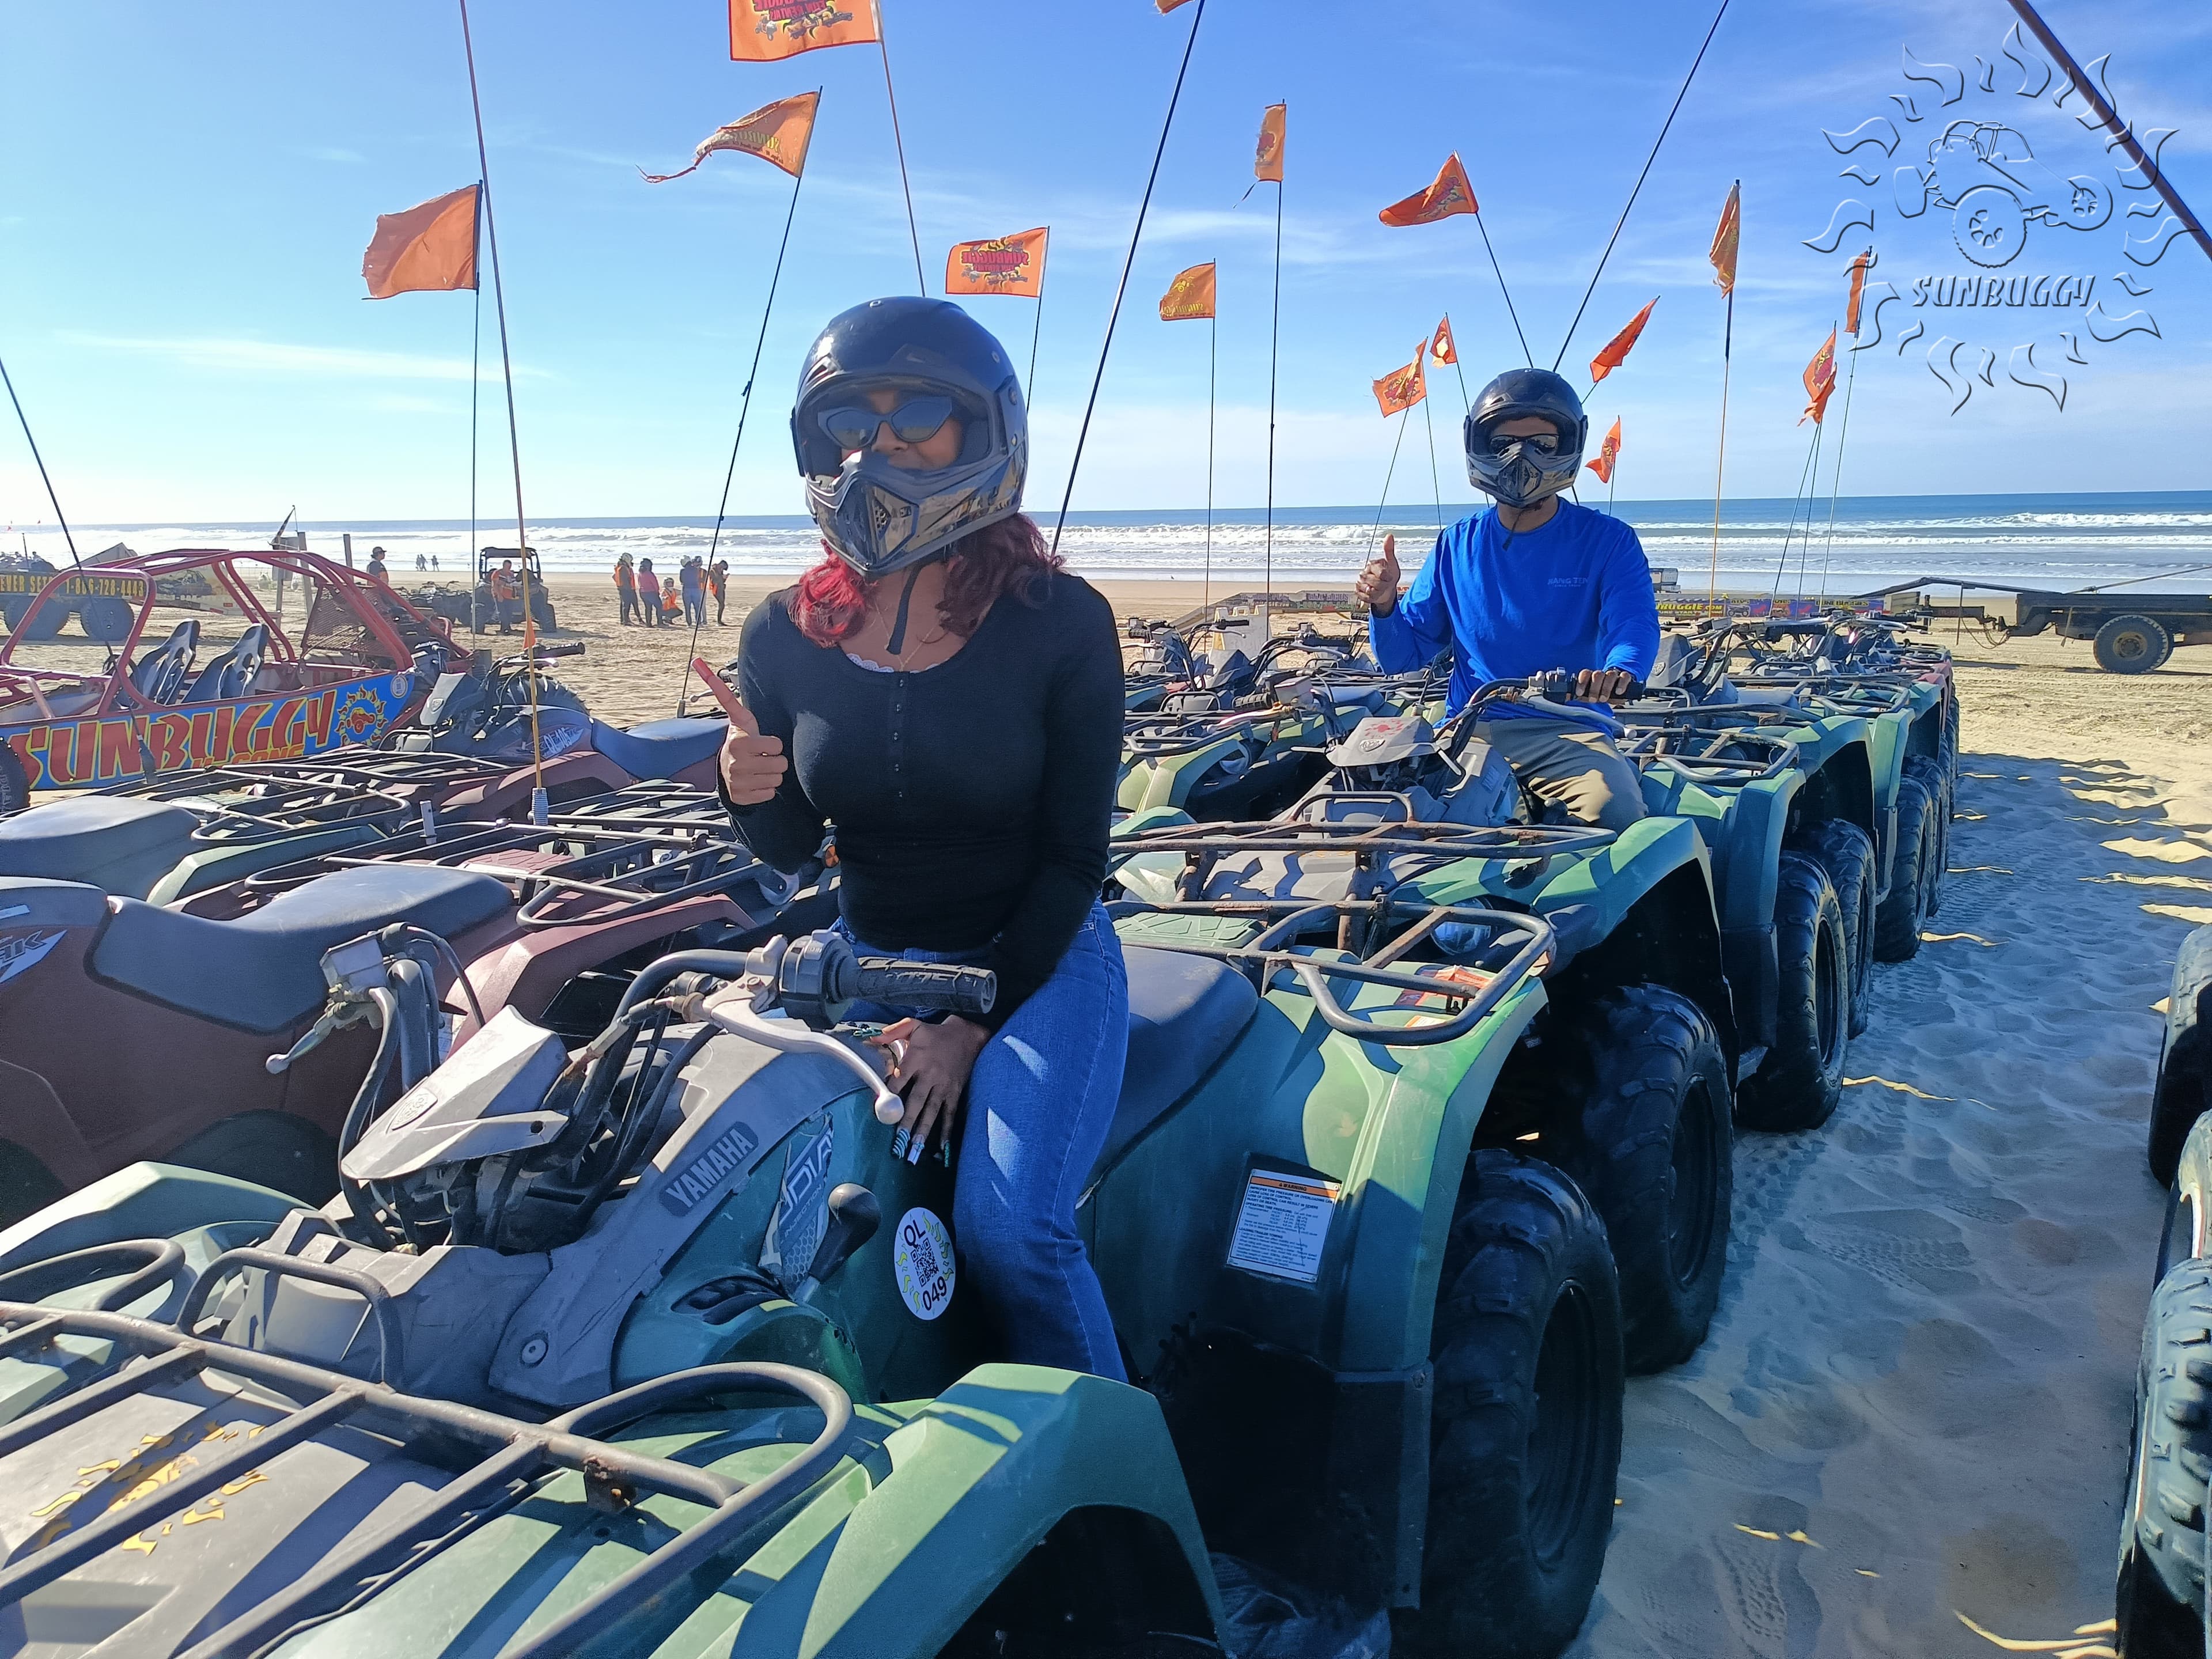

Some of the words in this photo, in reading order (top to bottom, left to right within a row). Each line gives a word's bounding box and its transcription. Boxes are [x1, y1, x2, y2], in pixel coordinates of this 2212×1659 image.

[7, 690, 337, 789] SUNBUGGY
[665, 1128, 755, 1208] YAMAHA
[1283, 1183, 1307, 1191] WARNING
[904, 1219, 926, 1249] QL
[922, 1276, 947, 1310] 049
